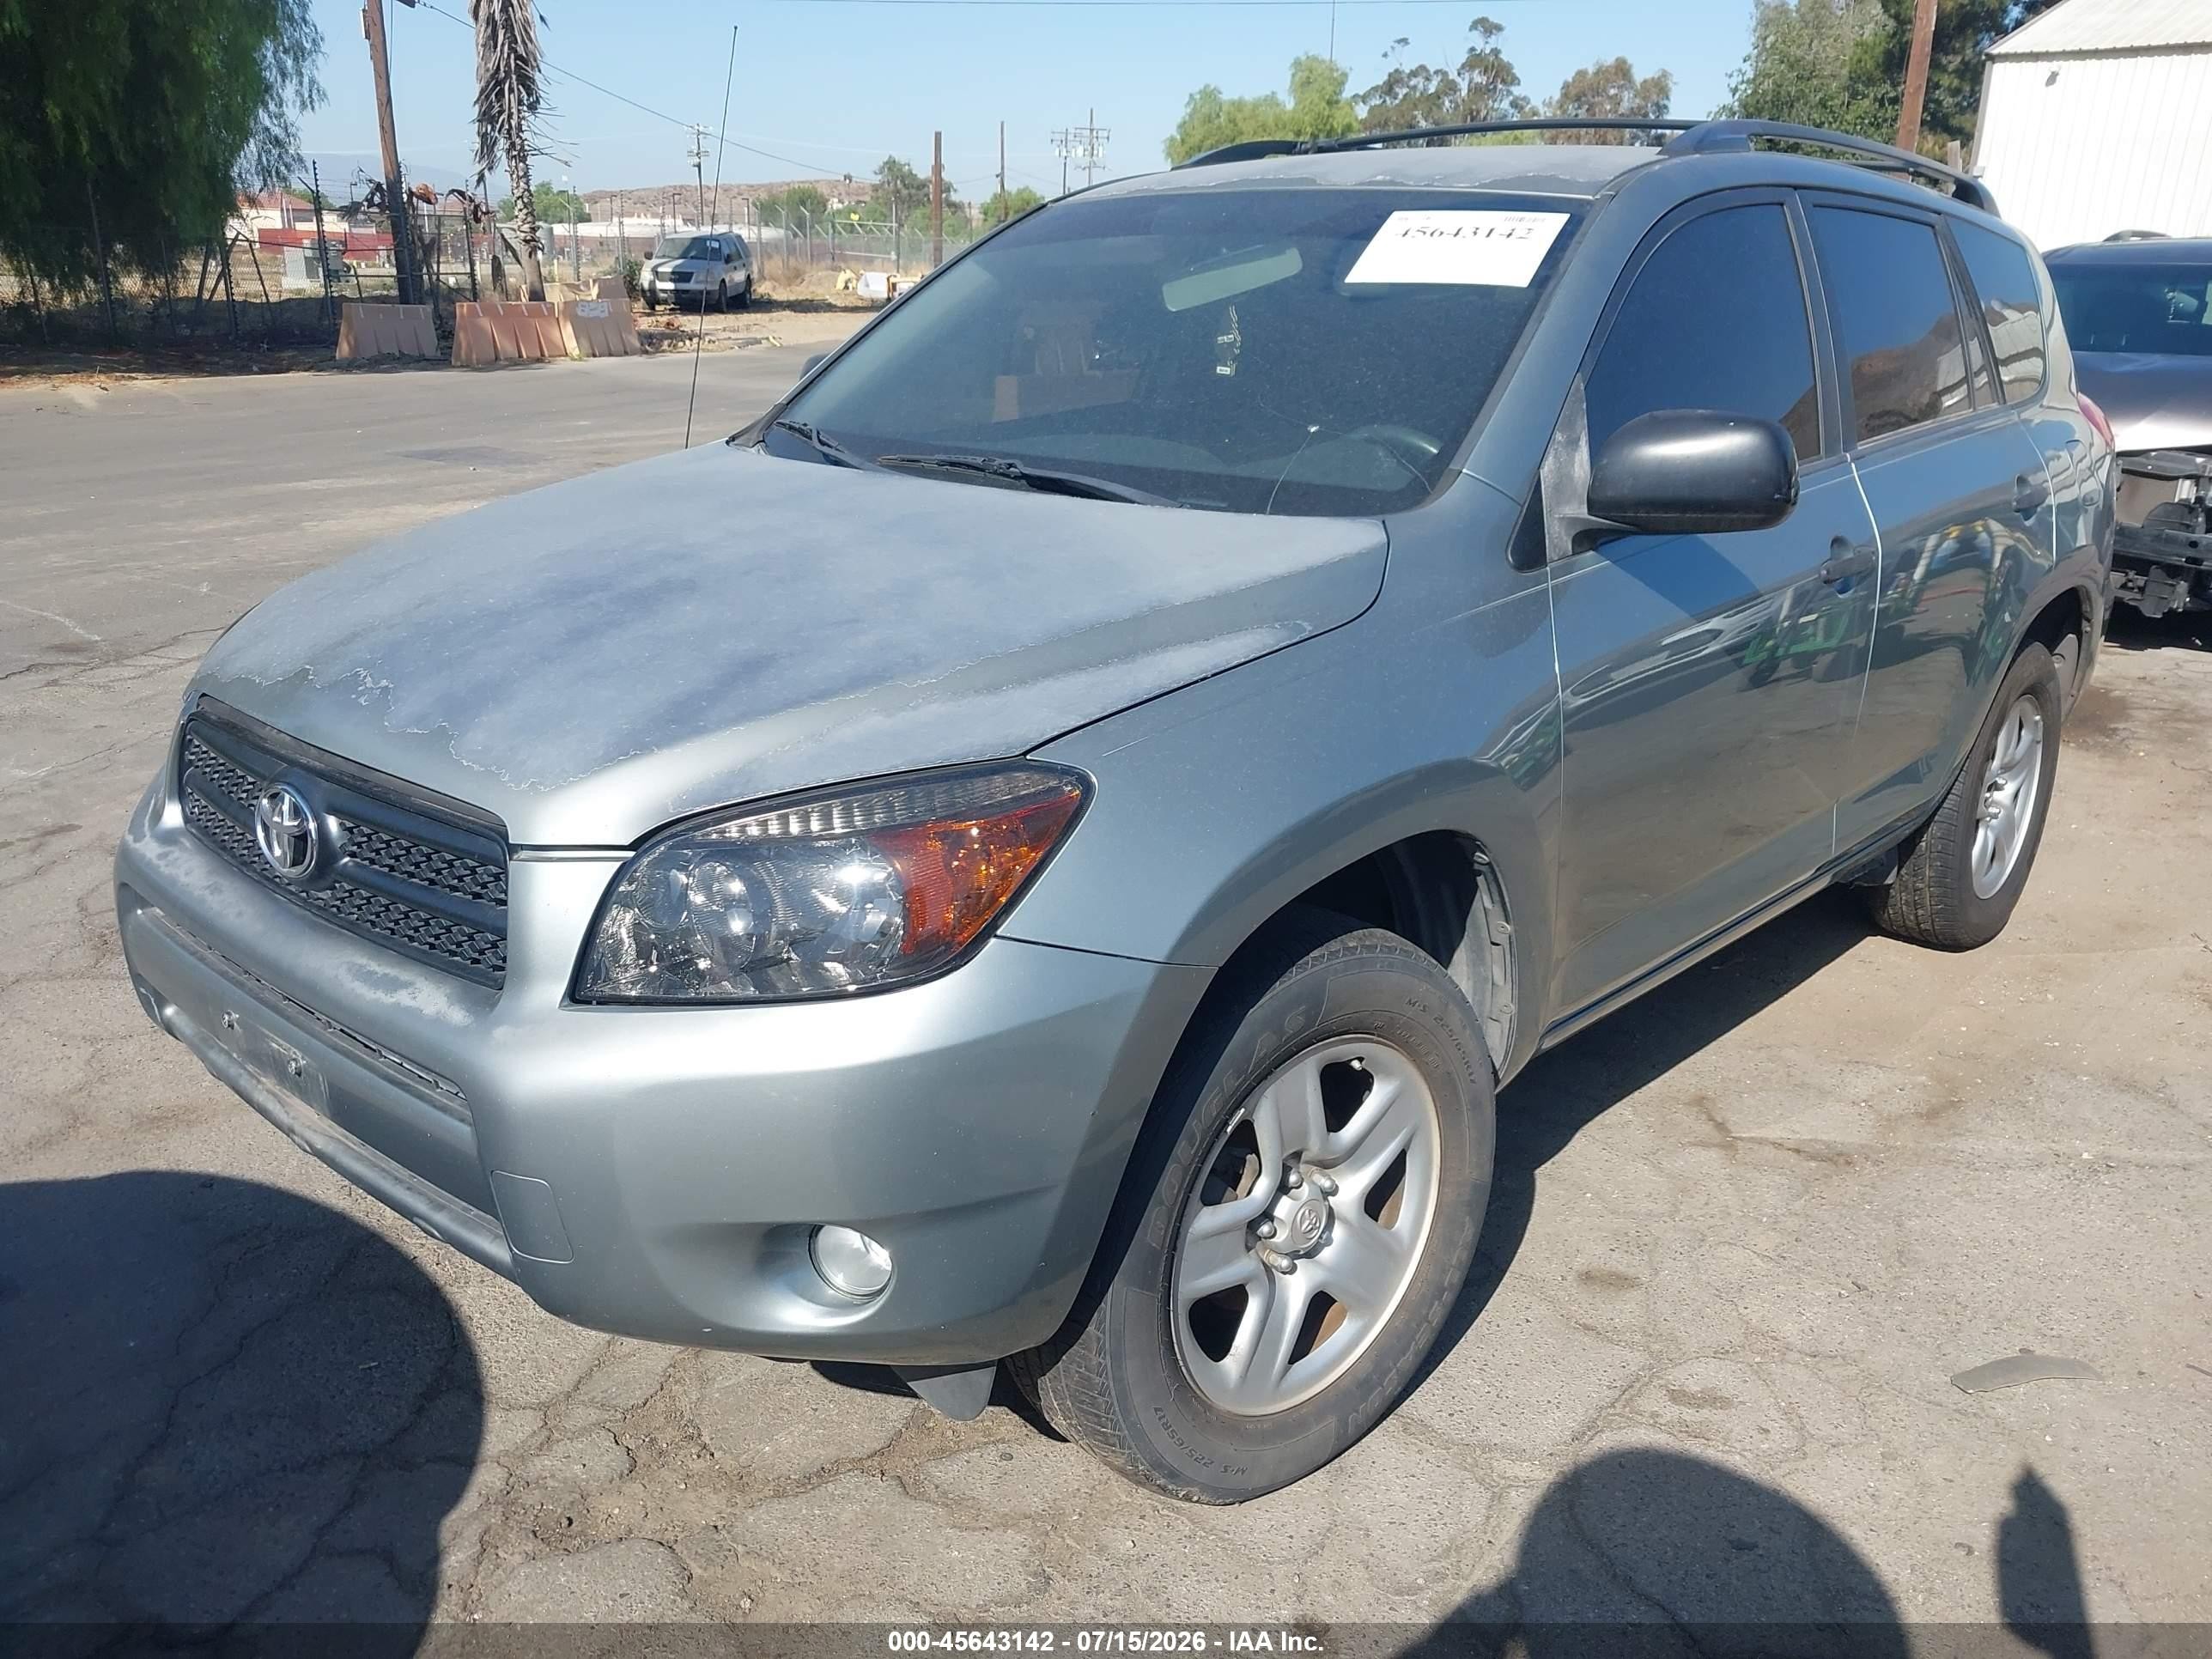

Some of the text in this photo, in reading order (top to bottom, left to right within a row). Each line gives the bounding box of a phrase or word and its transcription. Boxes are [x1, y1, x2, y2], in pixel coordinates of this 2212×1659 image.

[1395, 226, 1534, 240] 45643142
[1146, 1006, 1306, 1250] DOUGLAS
[1152, 1406, 1215, 1468] 225/65R17
